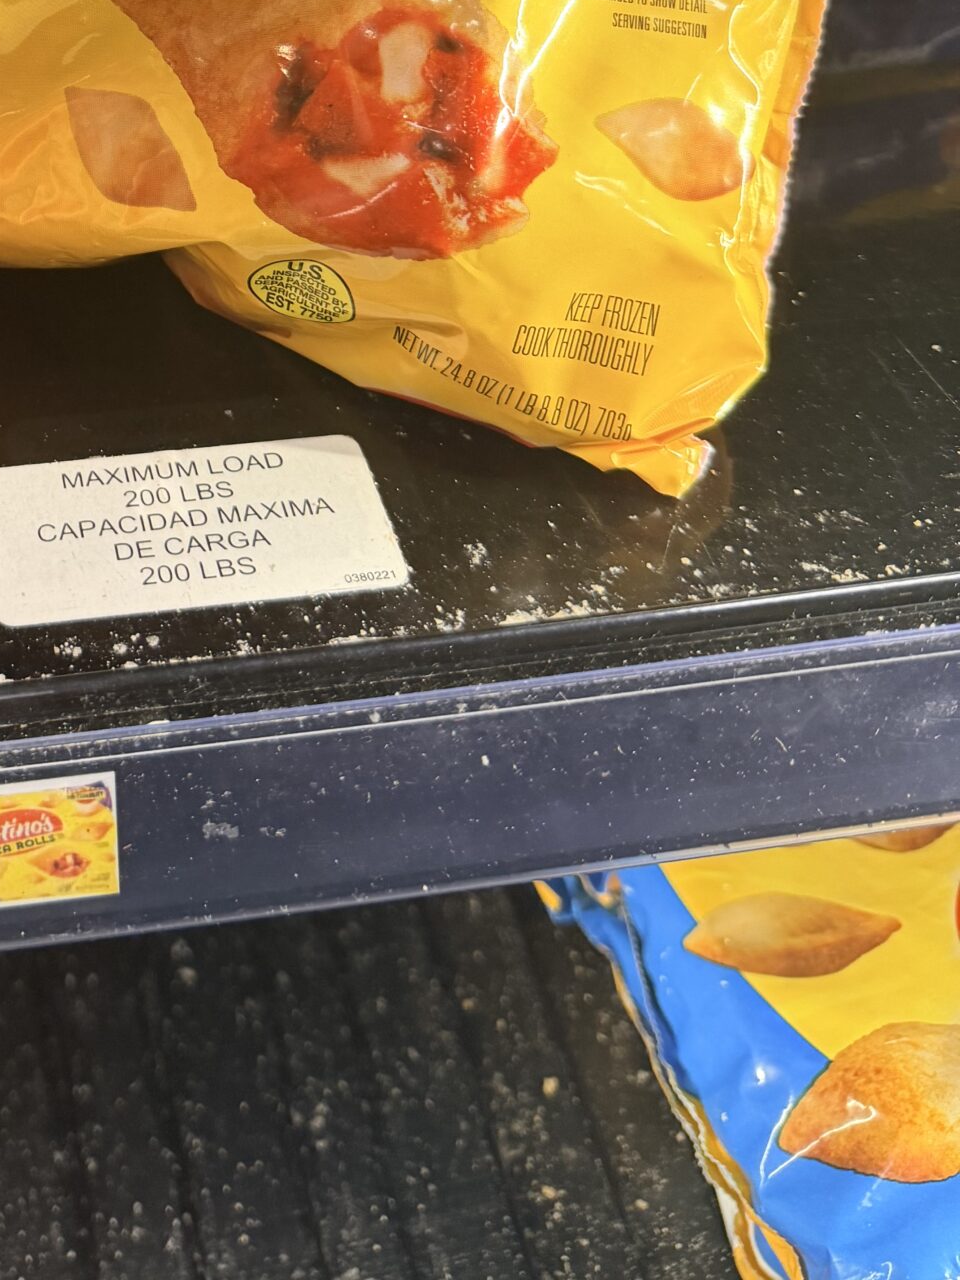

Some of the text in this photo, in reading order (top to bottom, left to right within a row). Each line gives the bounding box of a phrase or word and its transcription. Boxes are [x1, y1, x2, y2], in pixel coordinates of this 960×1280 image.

[612, 12, 707, 39] SERVING SUGGESTION
[272, 269, 337, 296] INSPECTED
[287, 261, 326, 283] U.S.
[254, 279, 349, 315] DEPARTMENT OF
[257, 274, 348, 308] AND PASSED BY
[260, 285, 340, 318] AGRICULTURE
[265, 291, 333, 322] EST. 7750
[564, 292, 661, 337] KEEP FROZEN
[512, 324, 654, 377] COOK THOROUGHLY
[393, 326, 420, 354] NET
[416, 339, 442, 370] WT.
[440, 356, 477, 389] 24.8
[476, 375, 500, 398] OZ
[515, 393, 538, 416] LB
[536, 395, 565, 426] 8.8
[564, 398, 592, 436] OZ)
[61, 452, 284, 489] MAXIMUM LOAD
[124, 481, 234, 508] 200 LBS
[37, 497, 335, 543] CAPACIDAD MAXIMA
[114, 529, 272, 561] DE CARGA
[140, 557, 257, 586] 200 LBS
[344, 570, 397, 584] 0380221
[16, 834, 56, 850] ROLLS
